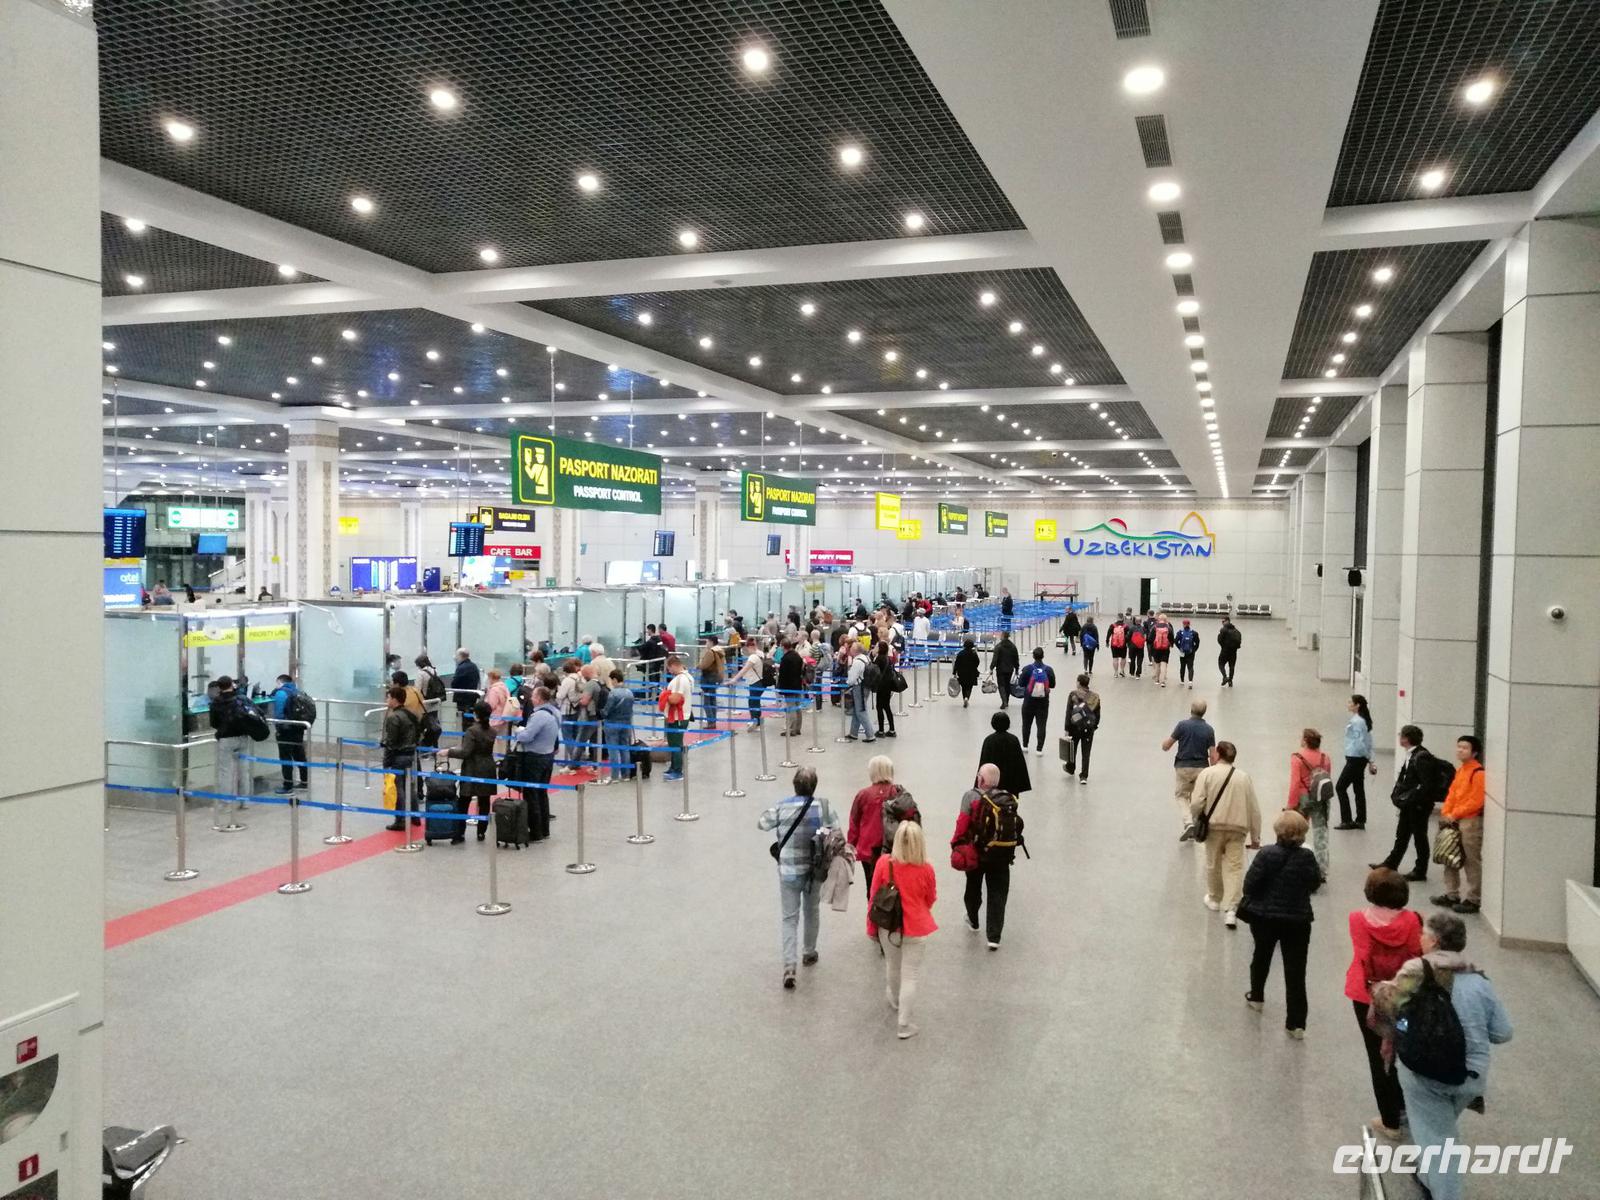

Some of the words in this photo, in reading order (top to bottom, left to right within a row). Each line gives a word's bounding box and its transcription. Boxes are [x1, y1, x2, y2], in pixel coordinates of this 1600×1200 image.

[560, 457, 610, 480] PASPORT
[611, 464, 658, 485] NAZORATI
[573, 485, 611, 500] PASSPORT
[612, 489, 643, 503] CONTROL
[766, 487, 791, 502] PASPORT
[490, 548, 511, 556] CAFE
[515, 548, 532, 556] BAR
[1063, 538, 1212, 560] UZBEKISTAN
